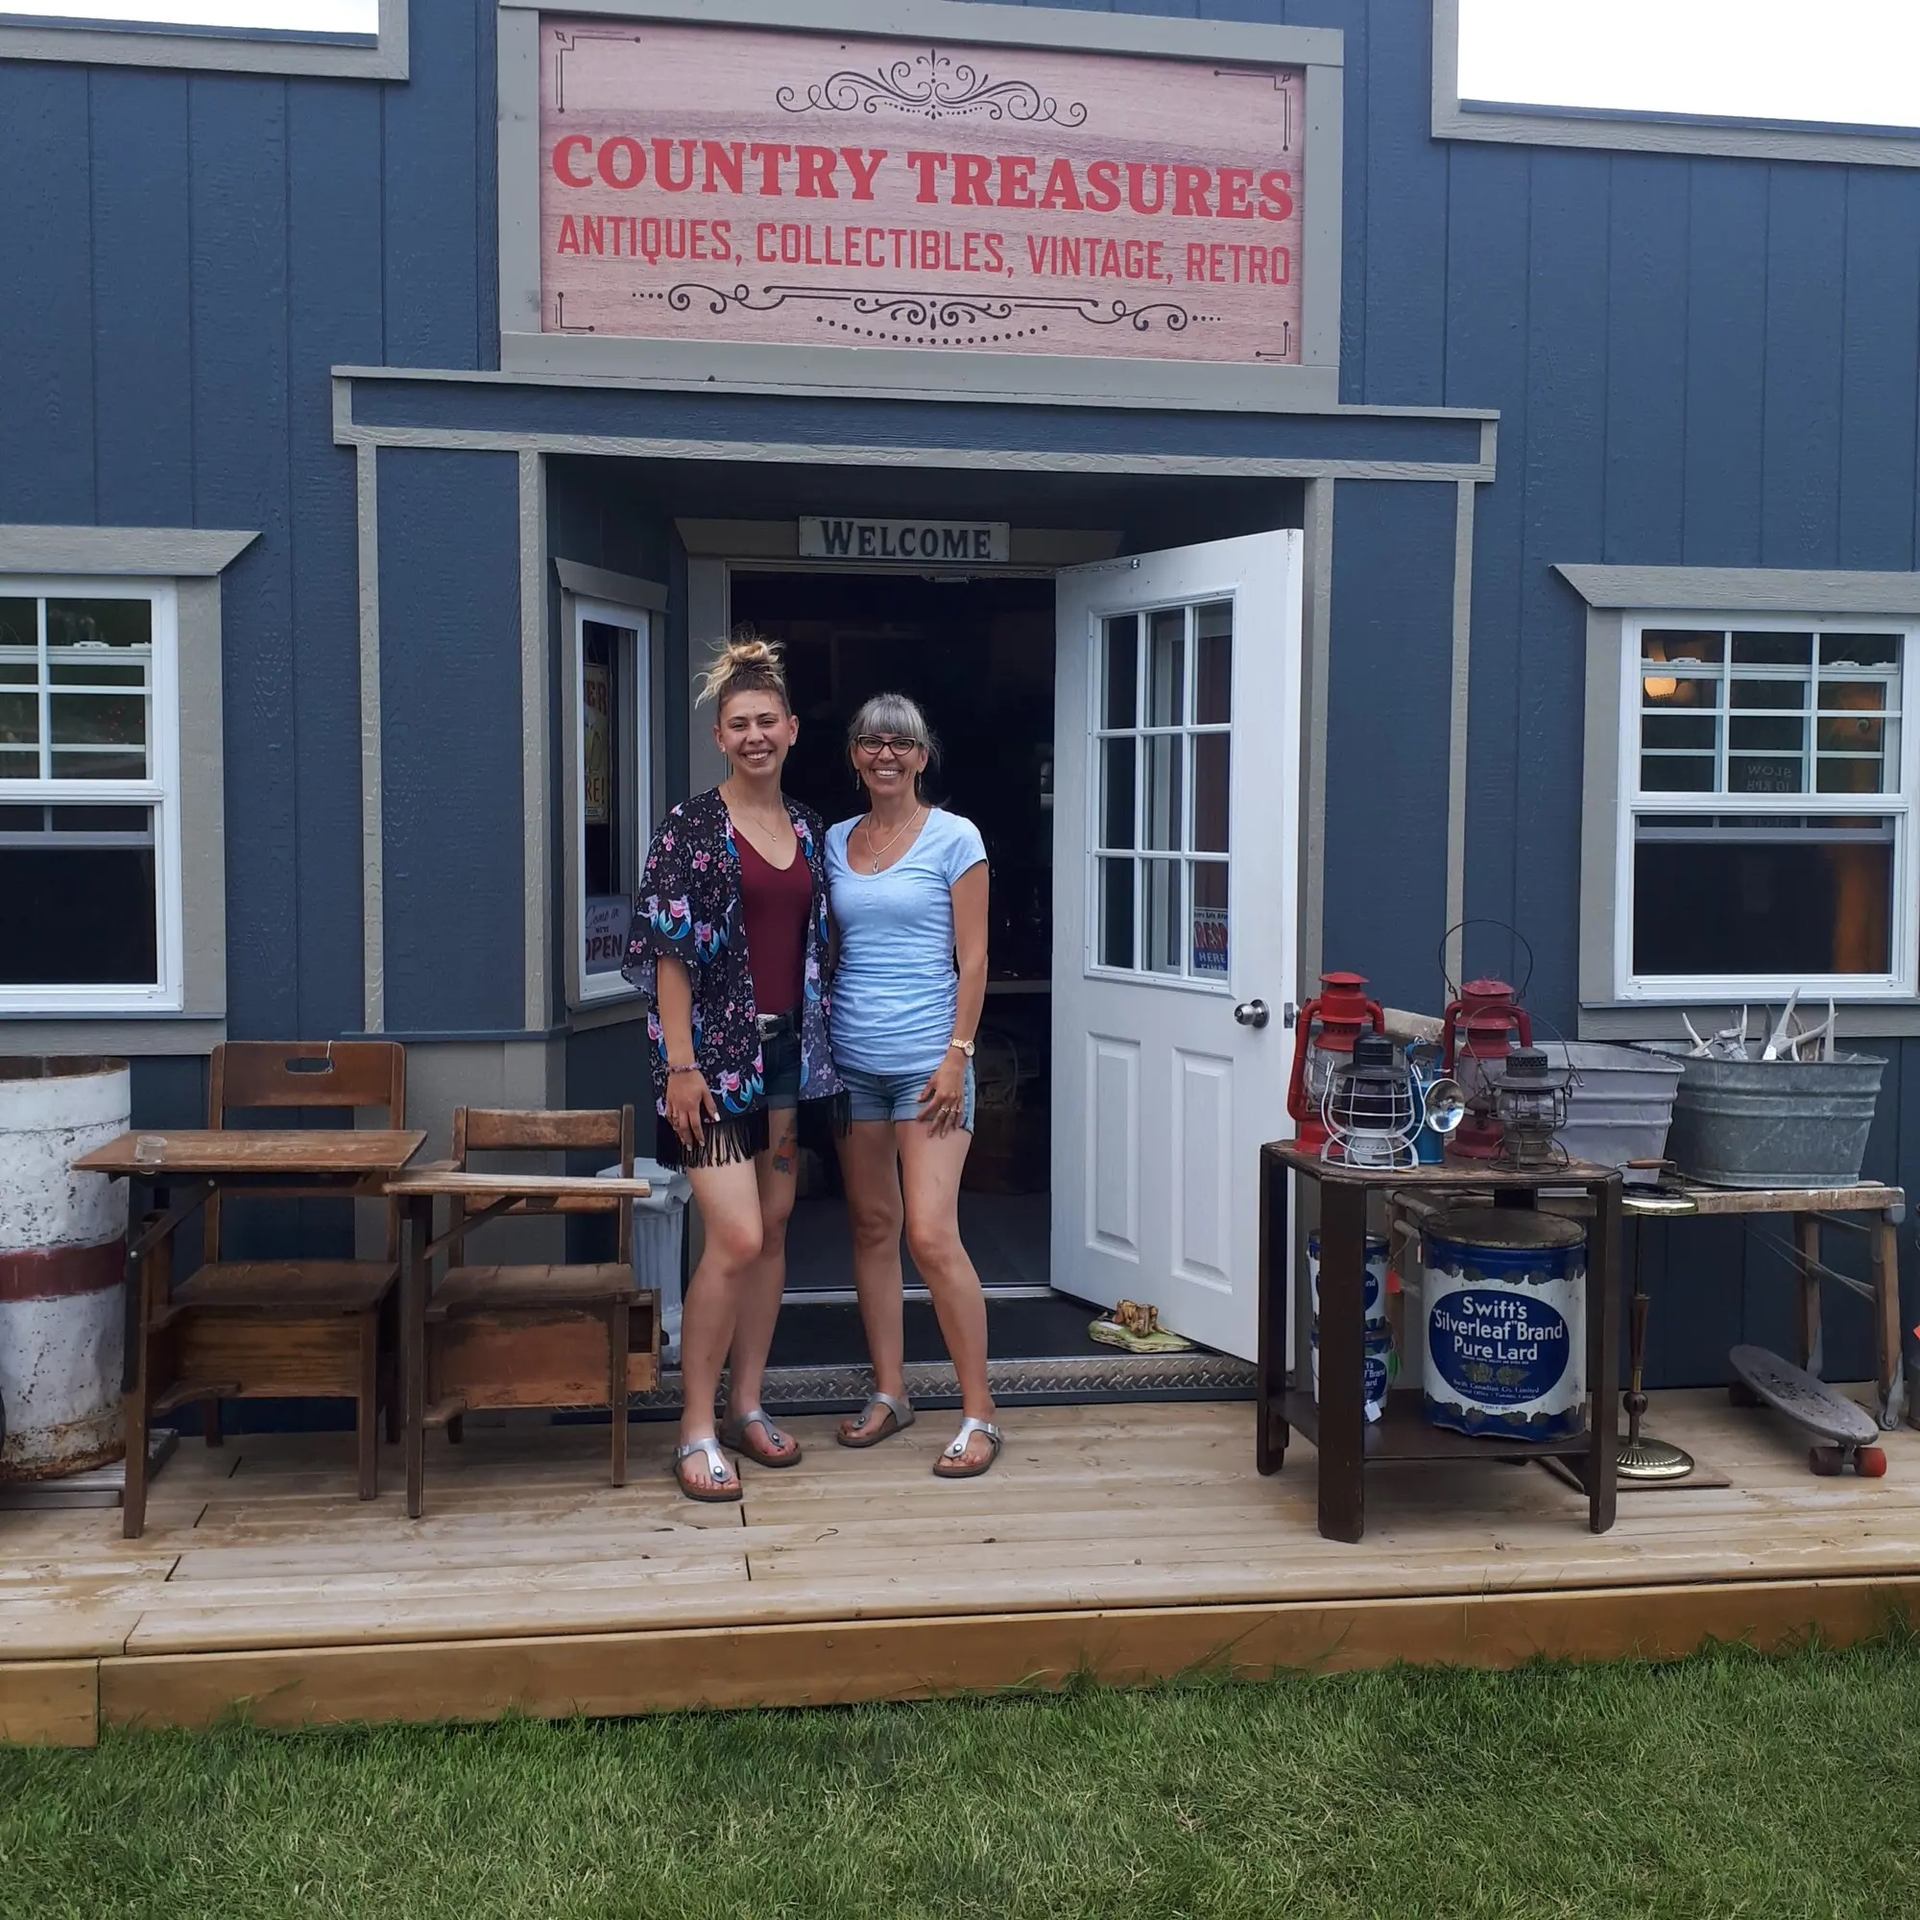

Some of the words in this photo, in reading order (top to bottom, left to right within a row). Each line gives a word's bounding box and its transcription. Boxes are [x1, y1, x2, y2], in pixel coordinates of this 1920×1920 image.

[552, 135, 888, 200] COUNTRY
[907, 151, 1293, 222] TREASURES
[557, 214, 743, 267] ANTIQUES,
[756, 222, 1014, 278] COLLECTIBLES,
[1027, 234, 1174, 285] VINTAGE,
[1186, 242, 1291, 285] RETRO
[820, 520, 991, 559] WELCOME
[1198, 952, 1226, 963] HERE
[1463, 1296, 1527, 1319] Swift's
[1517, 1319, 1563, 1341] Brand
[1454, 1335, 1493, 1358] Pure
[1497, 1341, 1538, 1361] Lard
